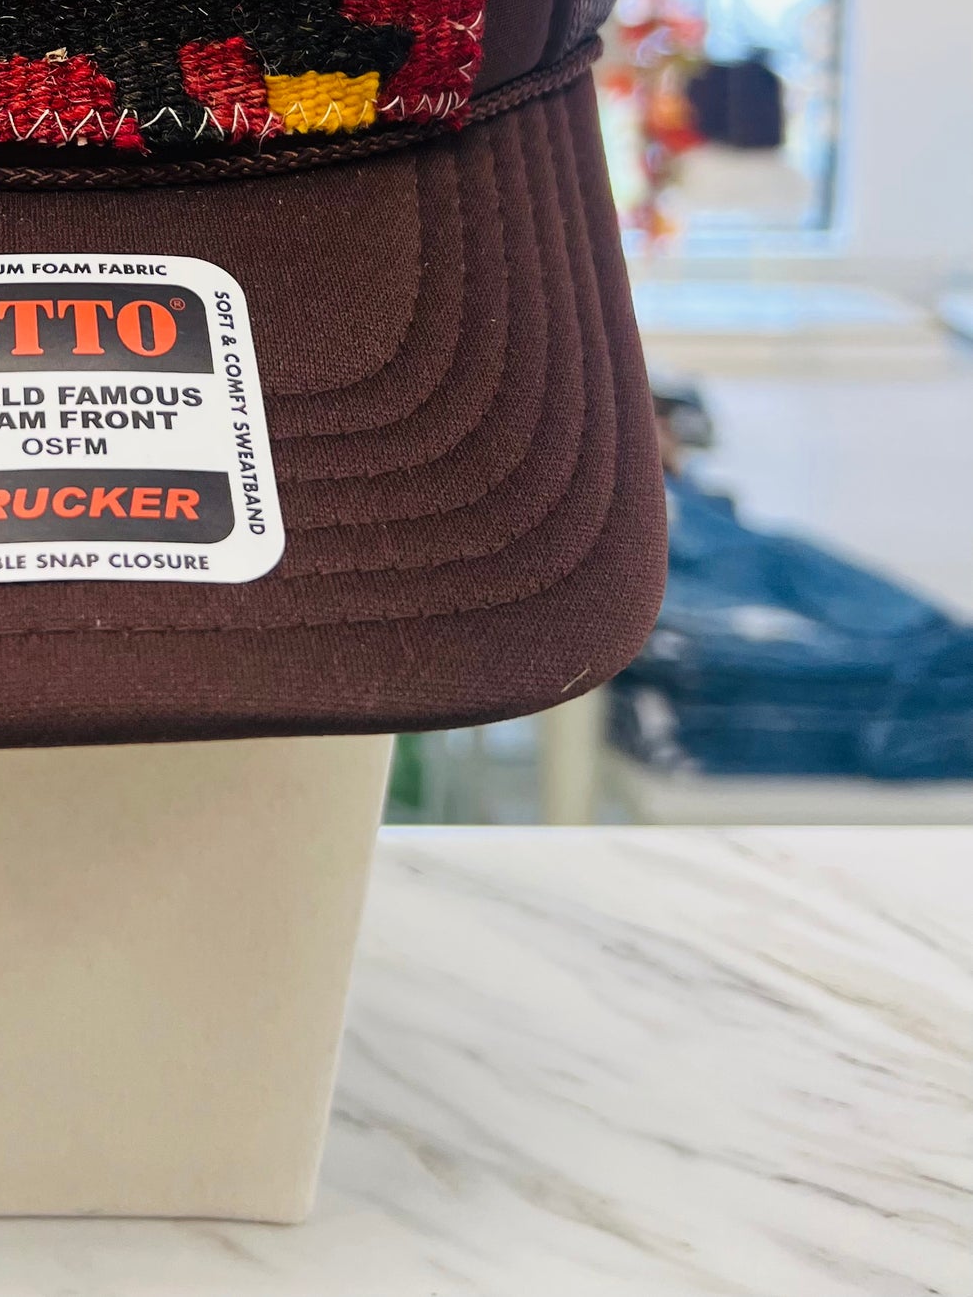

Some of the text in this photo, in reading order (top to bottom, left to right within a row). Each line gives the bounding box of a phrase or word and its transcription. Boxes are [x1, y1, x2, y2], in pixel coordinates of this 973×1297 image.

[32, 263, 91, 275] FOAM
[98, 263, 167, 276] FABRIC
[58, 387, 203, 406] FAMOUS
[60, 411, 178, 429] FRONT
[215, 291, 266, 535] SOFT & COMFY SWEATBAND
[22, 438, 107, 455] OSFM
[36, 554, 99, 569] SNAP
[108, 554, 209, 570] CLOSURE
